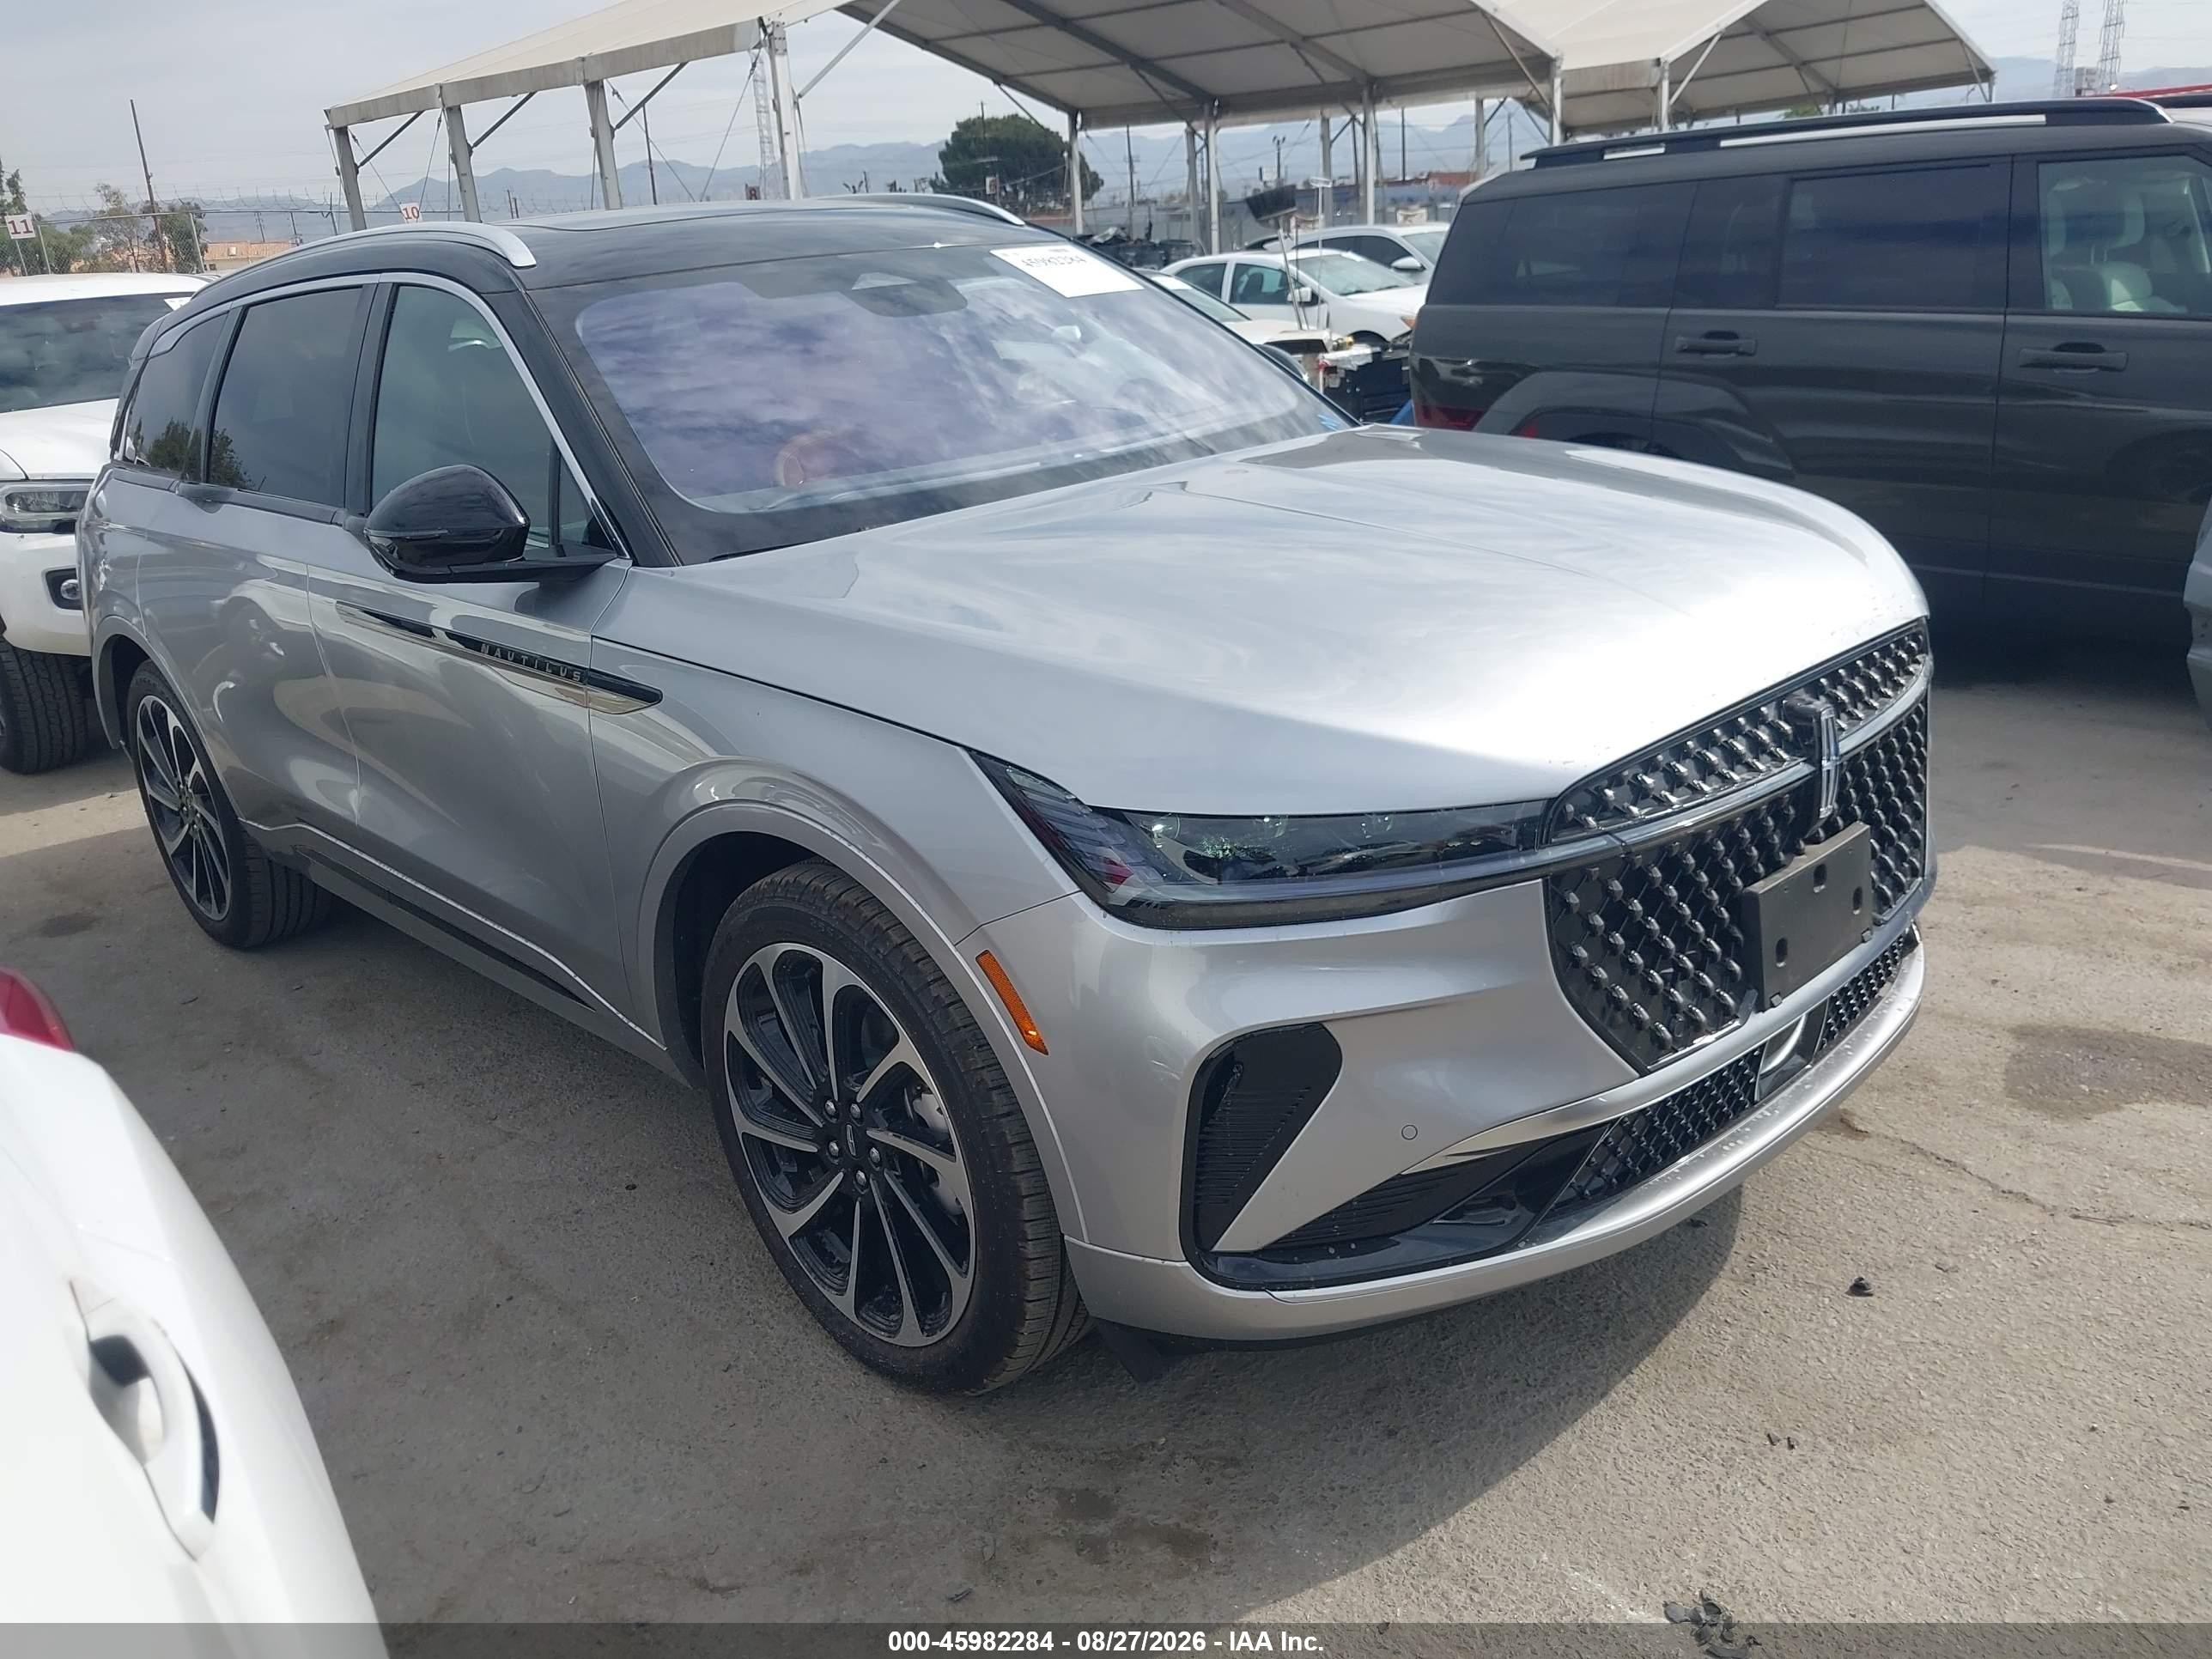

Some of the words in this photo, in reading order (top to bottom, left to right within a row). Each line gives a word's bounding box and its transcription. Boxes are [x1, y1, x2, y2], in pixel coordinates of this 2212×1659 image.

[403, 206, 419, 220] 10
[8, 218, 33, 235] 11
[480, 642, 582, 682] NAUTILUS
